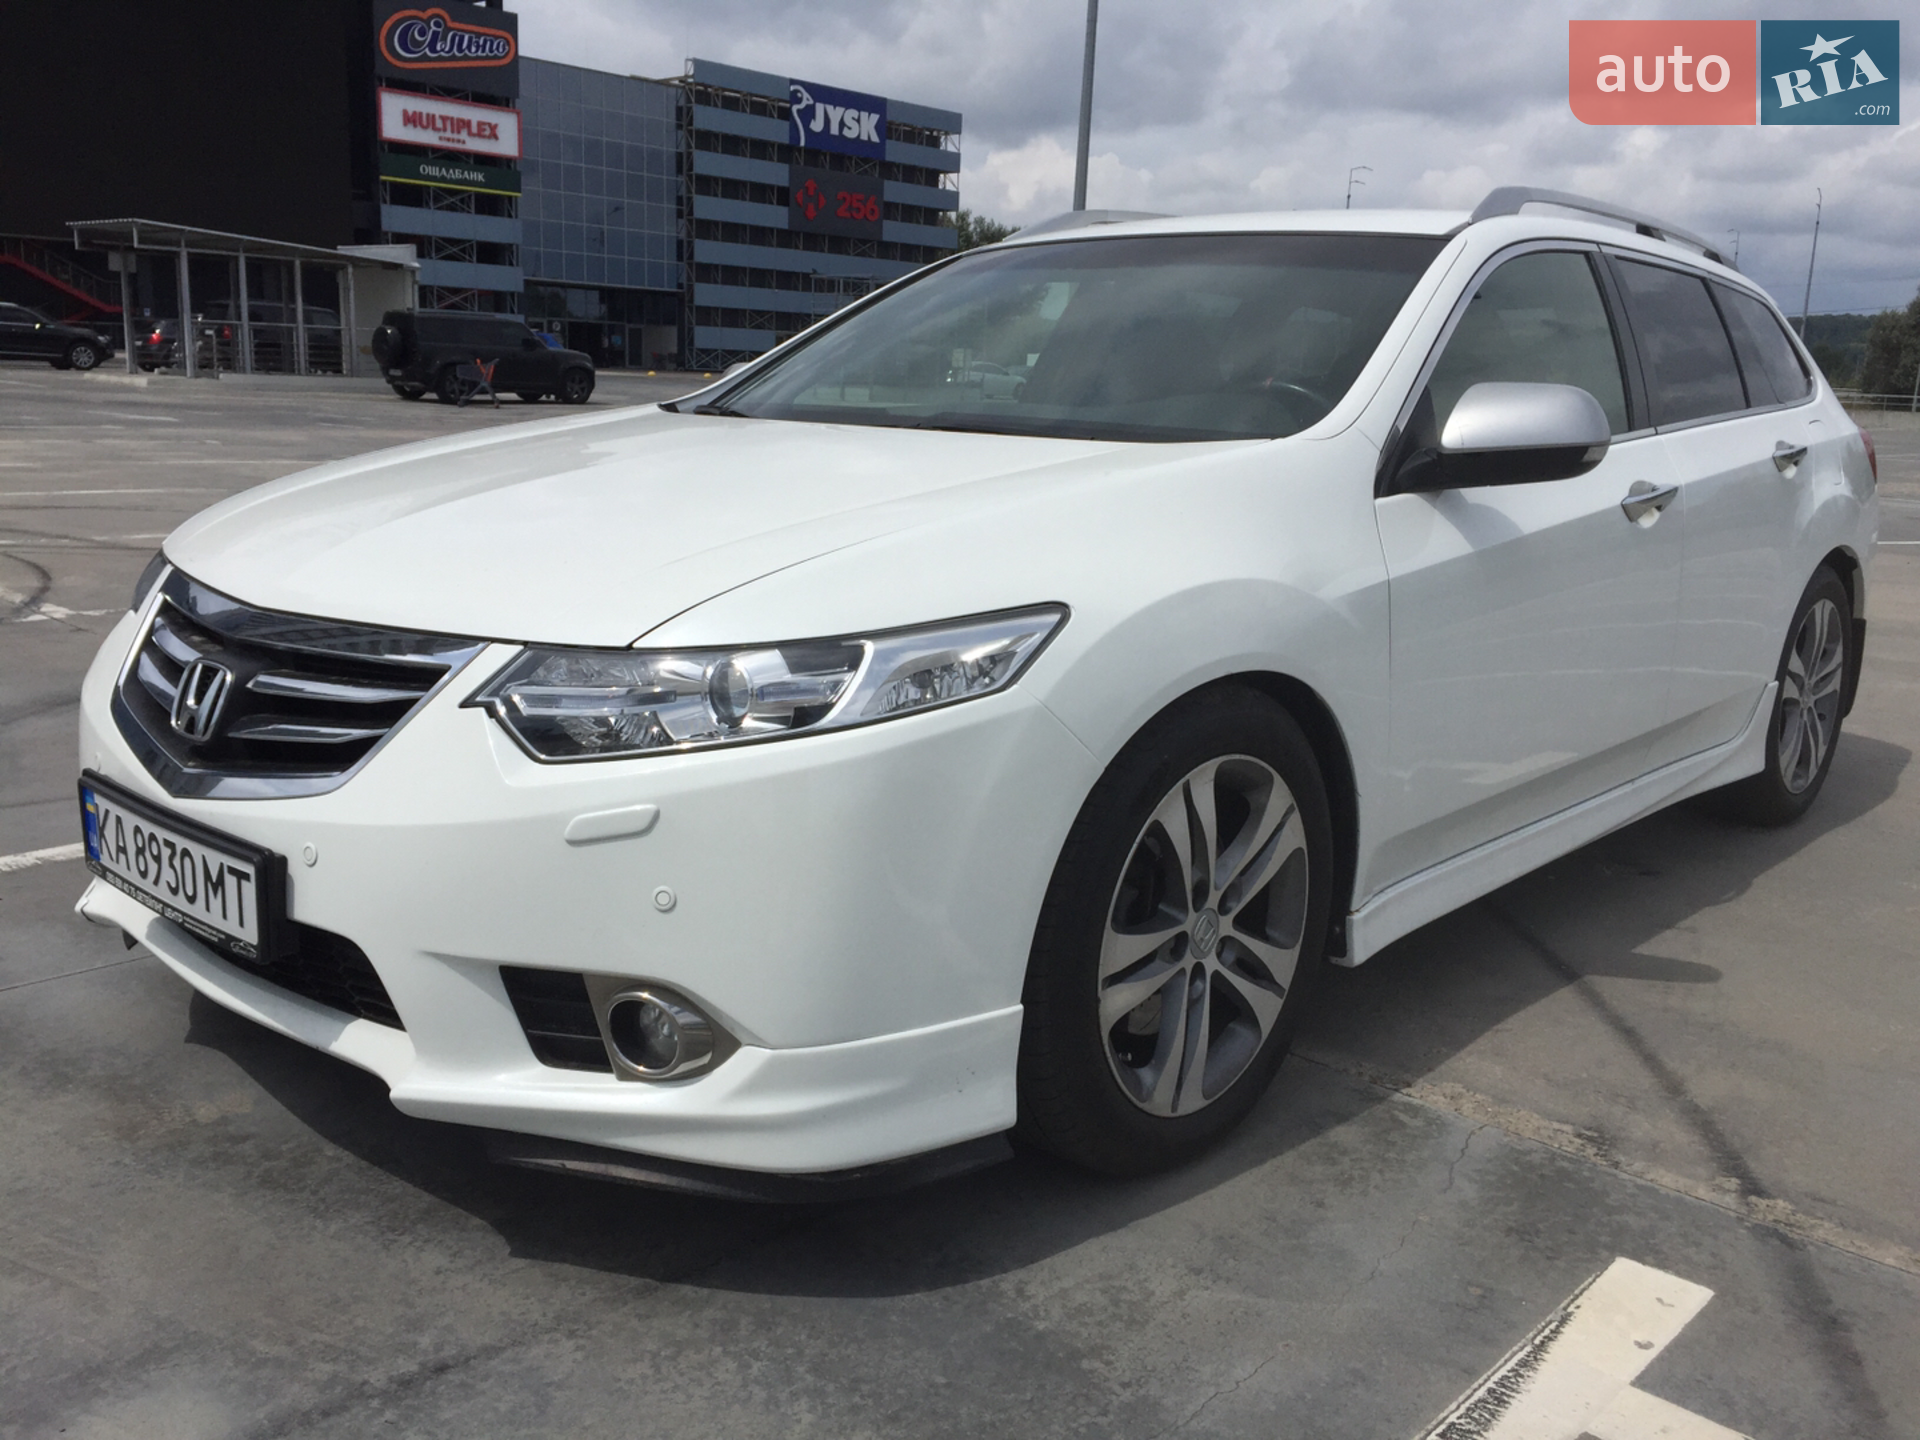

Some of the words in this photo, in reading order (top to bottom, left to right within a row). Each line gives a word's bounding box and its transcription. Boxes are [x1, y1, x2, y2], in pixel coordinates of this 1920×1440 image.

[394, 18, 509, 58] Сільпо
[402, 109, 499, 141] MULTIPLEX
[809, 102, 880, 143] JYSK
[419, 164, 485, 182] ОЩАДБАНК
[836, 192, 880, 222] 256
